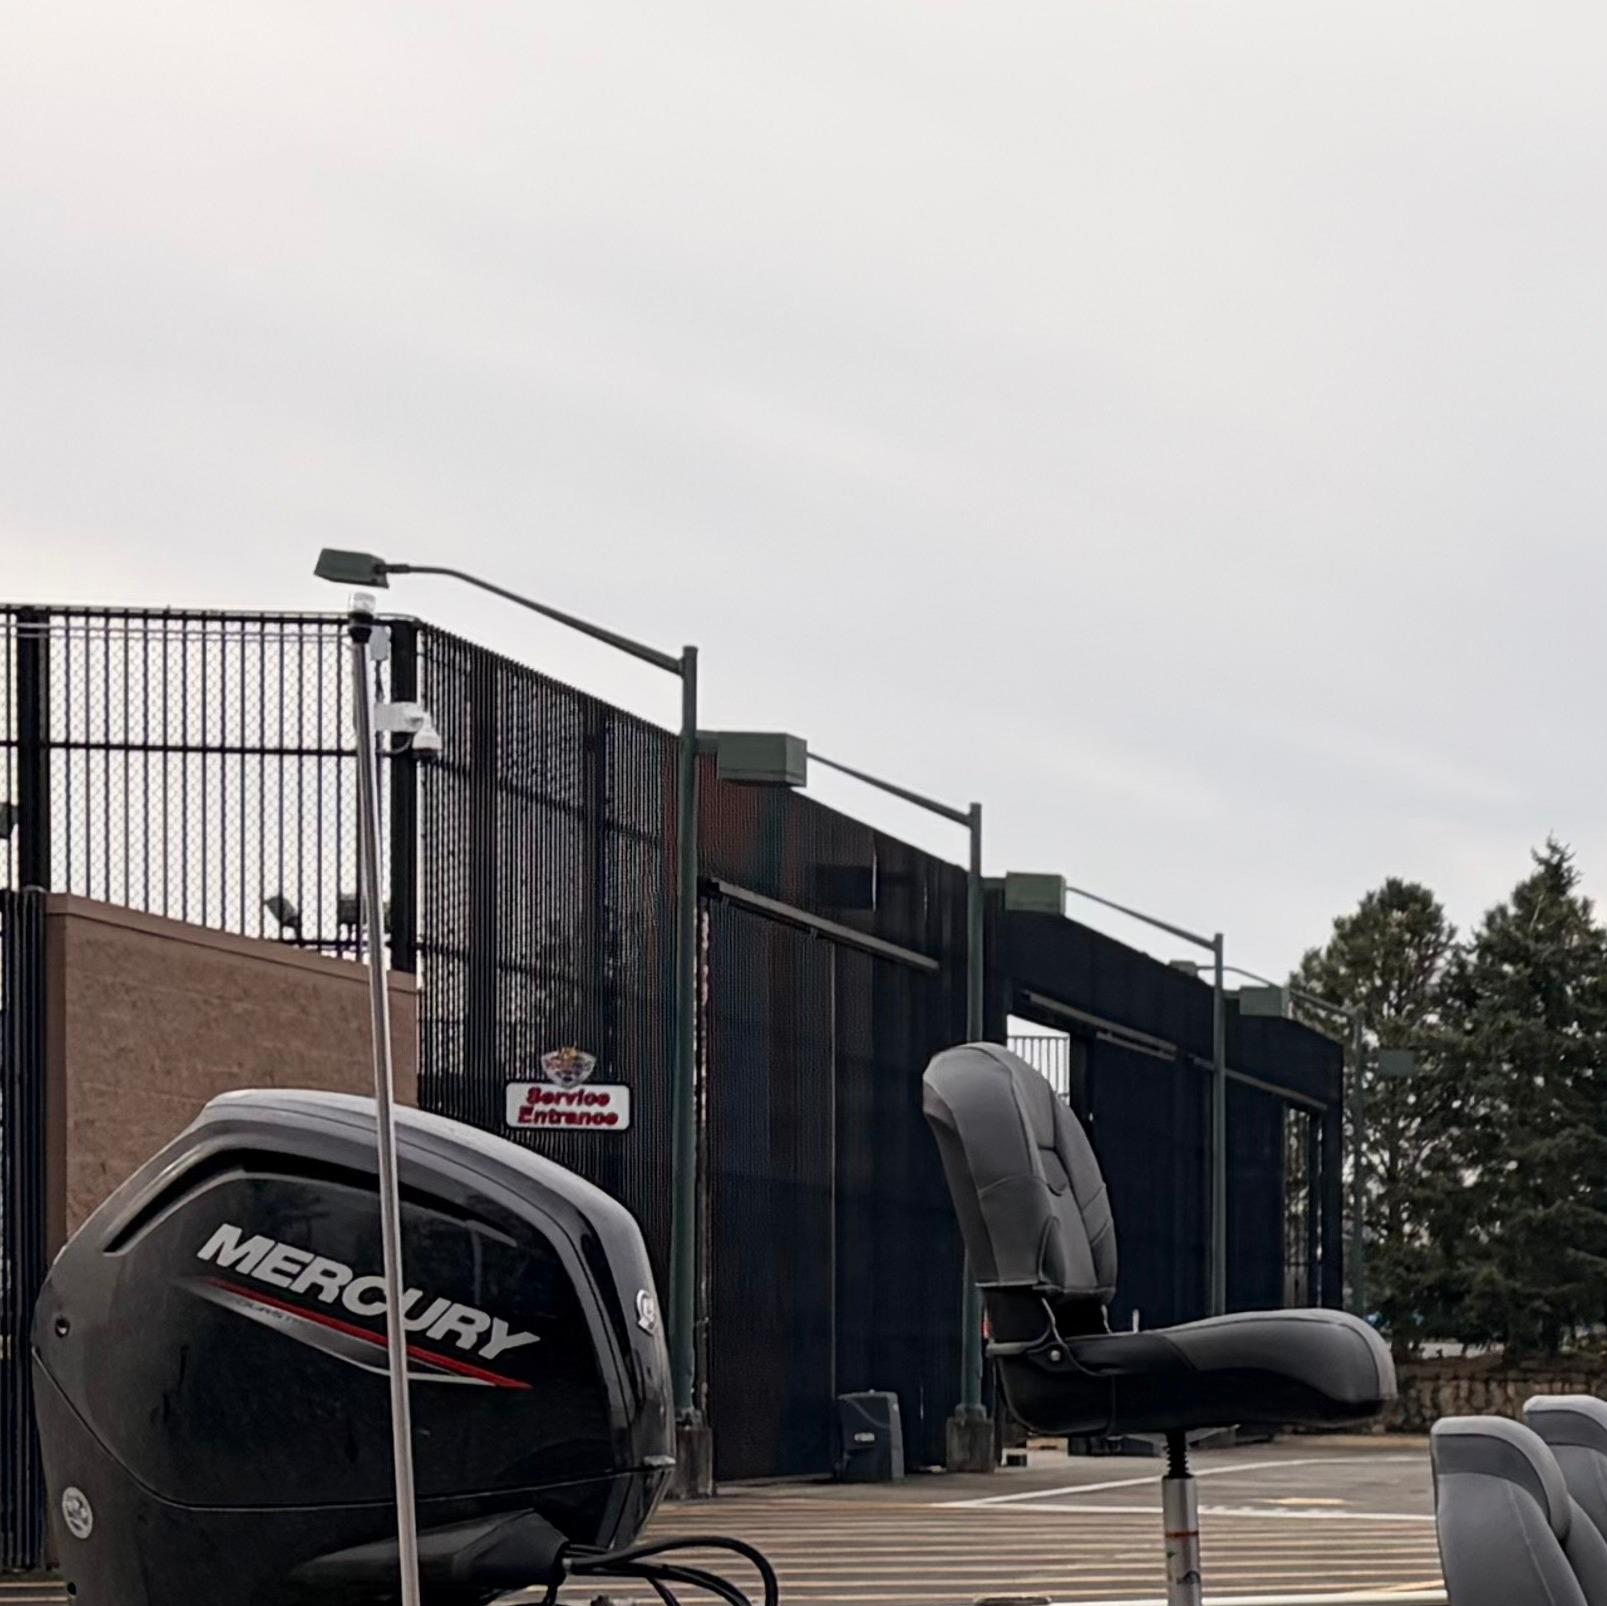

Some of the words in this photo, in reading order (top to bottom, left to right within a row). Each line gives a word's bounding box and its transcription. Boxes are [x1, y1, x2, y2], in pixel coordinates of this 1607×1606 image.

[526, 1086, 611, 1106] Service
[517, 1105, 619, 1126] Entrance
[197, 1223, 541, 1360] MERCURY
